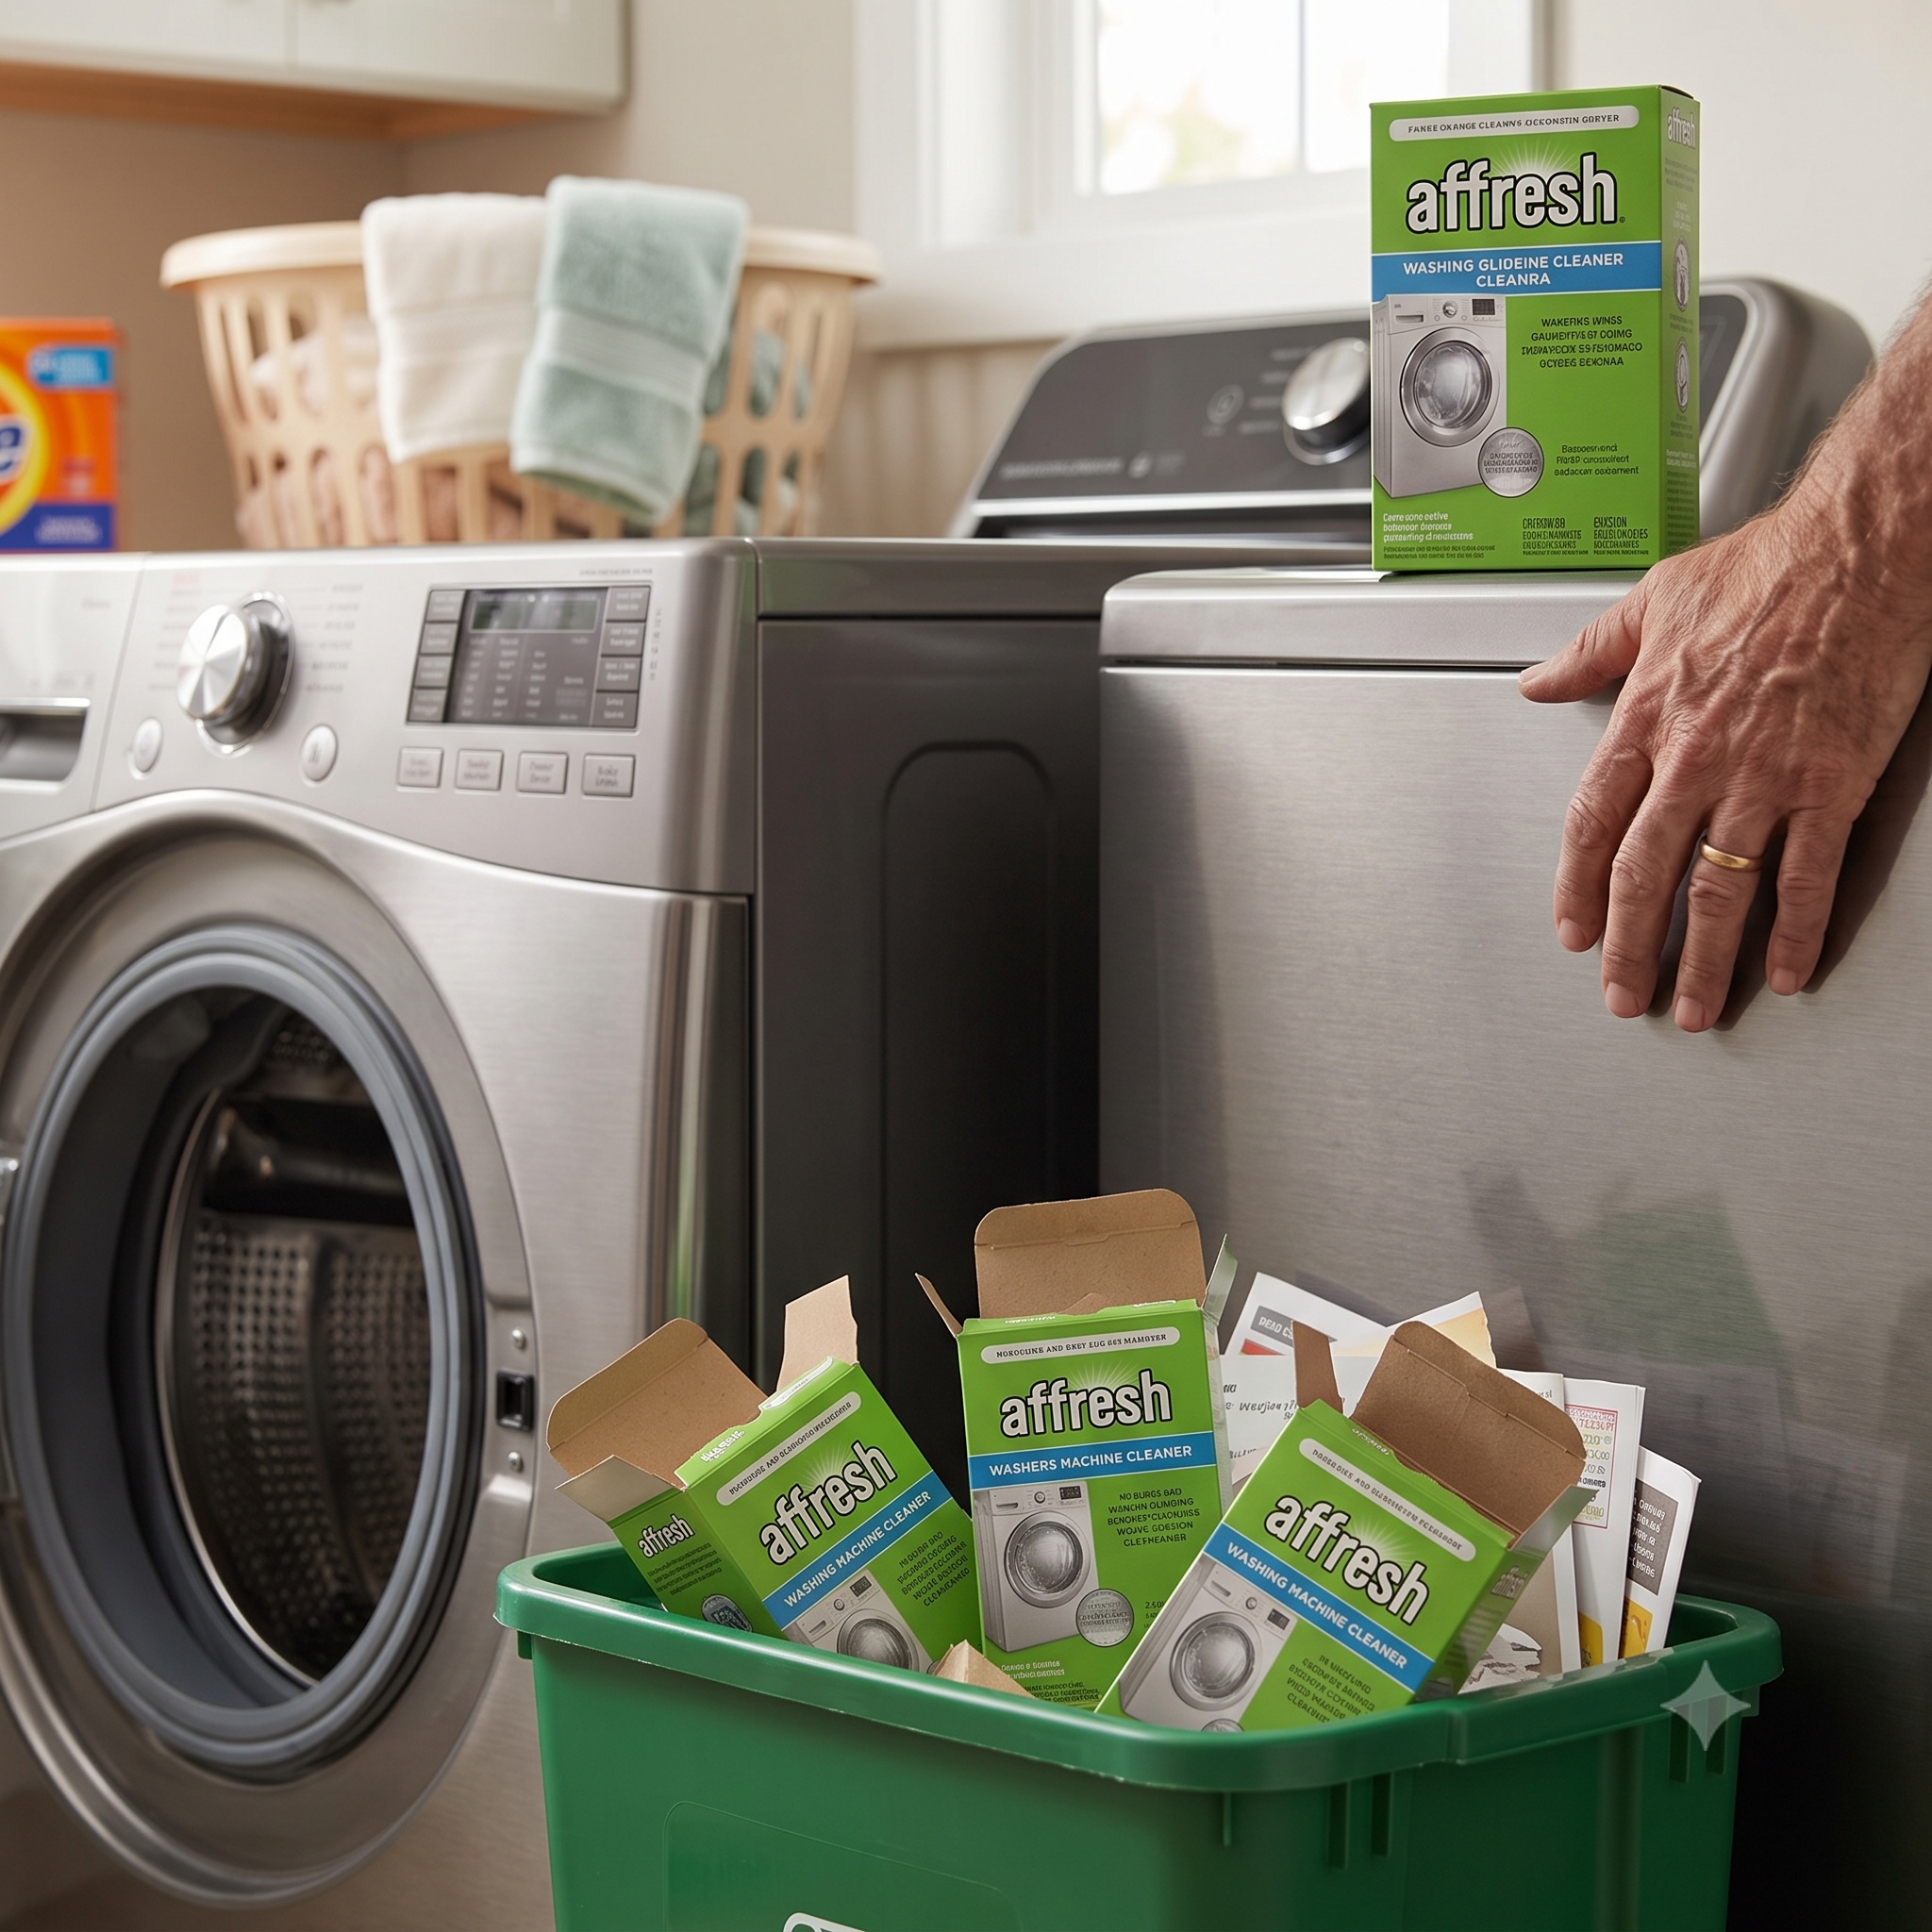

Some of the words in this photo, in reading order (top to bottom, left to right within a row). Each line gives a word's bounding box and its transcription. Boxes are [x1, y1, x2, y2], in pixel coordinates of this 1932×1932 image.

[1406, 151, 1617, 234] affresh
[1403, 258, 1474, 275] WASHING
[1553, 253, 1624, 269] CLEANER
[1475, 273, 1551, 288] CLEANRA
[1046, 1344, 1064, 1353] AND
[1000, 1368, 1173, 1438] affresh
[989, 1459, 1058, 1476] WASHERS
[1060, 1452, 1124, 1469] MACHINE
[1126, 1445, 1192, 1462] CLEANER
[638, 1513, 695, 1558] affresh
[758, 1440, 898, 1566] affresh
[784, 1563, 837, 1607] WASHING
[835, 1526, 885, 1569] MACHINE
[883, 1491, 932, 1531] CLEANER
[1264, 1494, 1430, 1626] affresh
[1226, 1541, 1289, 1590] WASHING
[1288, 1583, 1349, 1629] MACHINE
[1347, 1624, 1407, 1669] CLEANER
